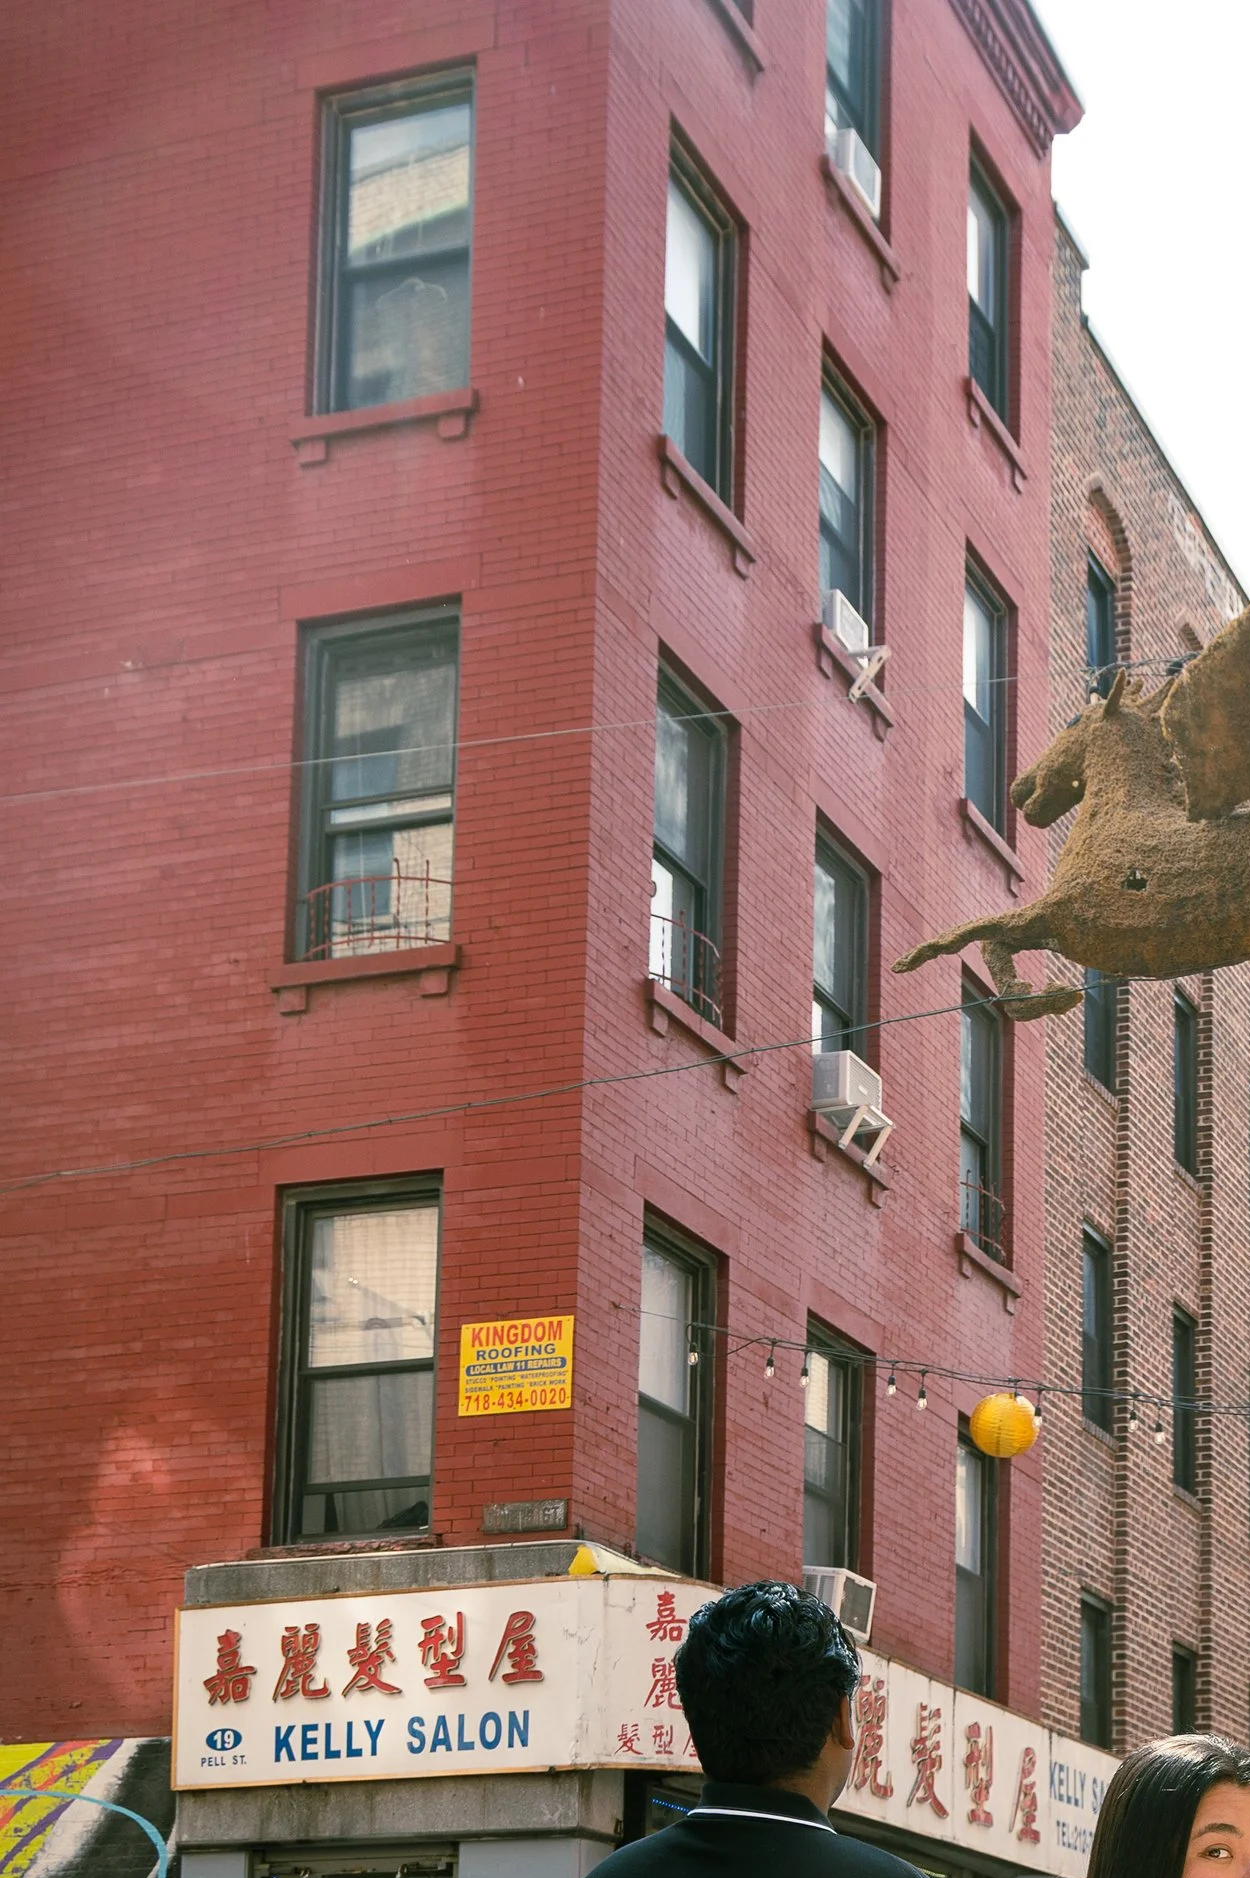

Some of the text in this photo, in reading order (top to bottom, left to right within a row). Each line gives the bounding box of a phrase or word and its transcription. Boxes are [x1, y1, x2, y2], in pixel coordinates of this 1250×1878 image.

[471, 1320, 562, 1348] KINGDOM
[476, 1343, 556, 1361] ROOFING
[470, 1358, 562, 1375] LOCAL LAW 11 REPAIRS
[465, 1387, 566, 1412] 718-434-0020
[203, 1610, 545, 1706] 嘉麗髮型屋
[213, 1730, 235, 1749] 19
[273, 1710, 530, 1763] KELLY SALON
[201, 1754, 247, 1767] PELL ST.
[1048, 1761, 1086, 1809] KELLY
